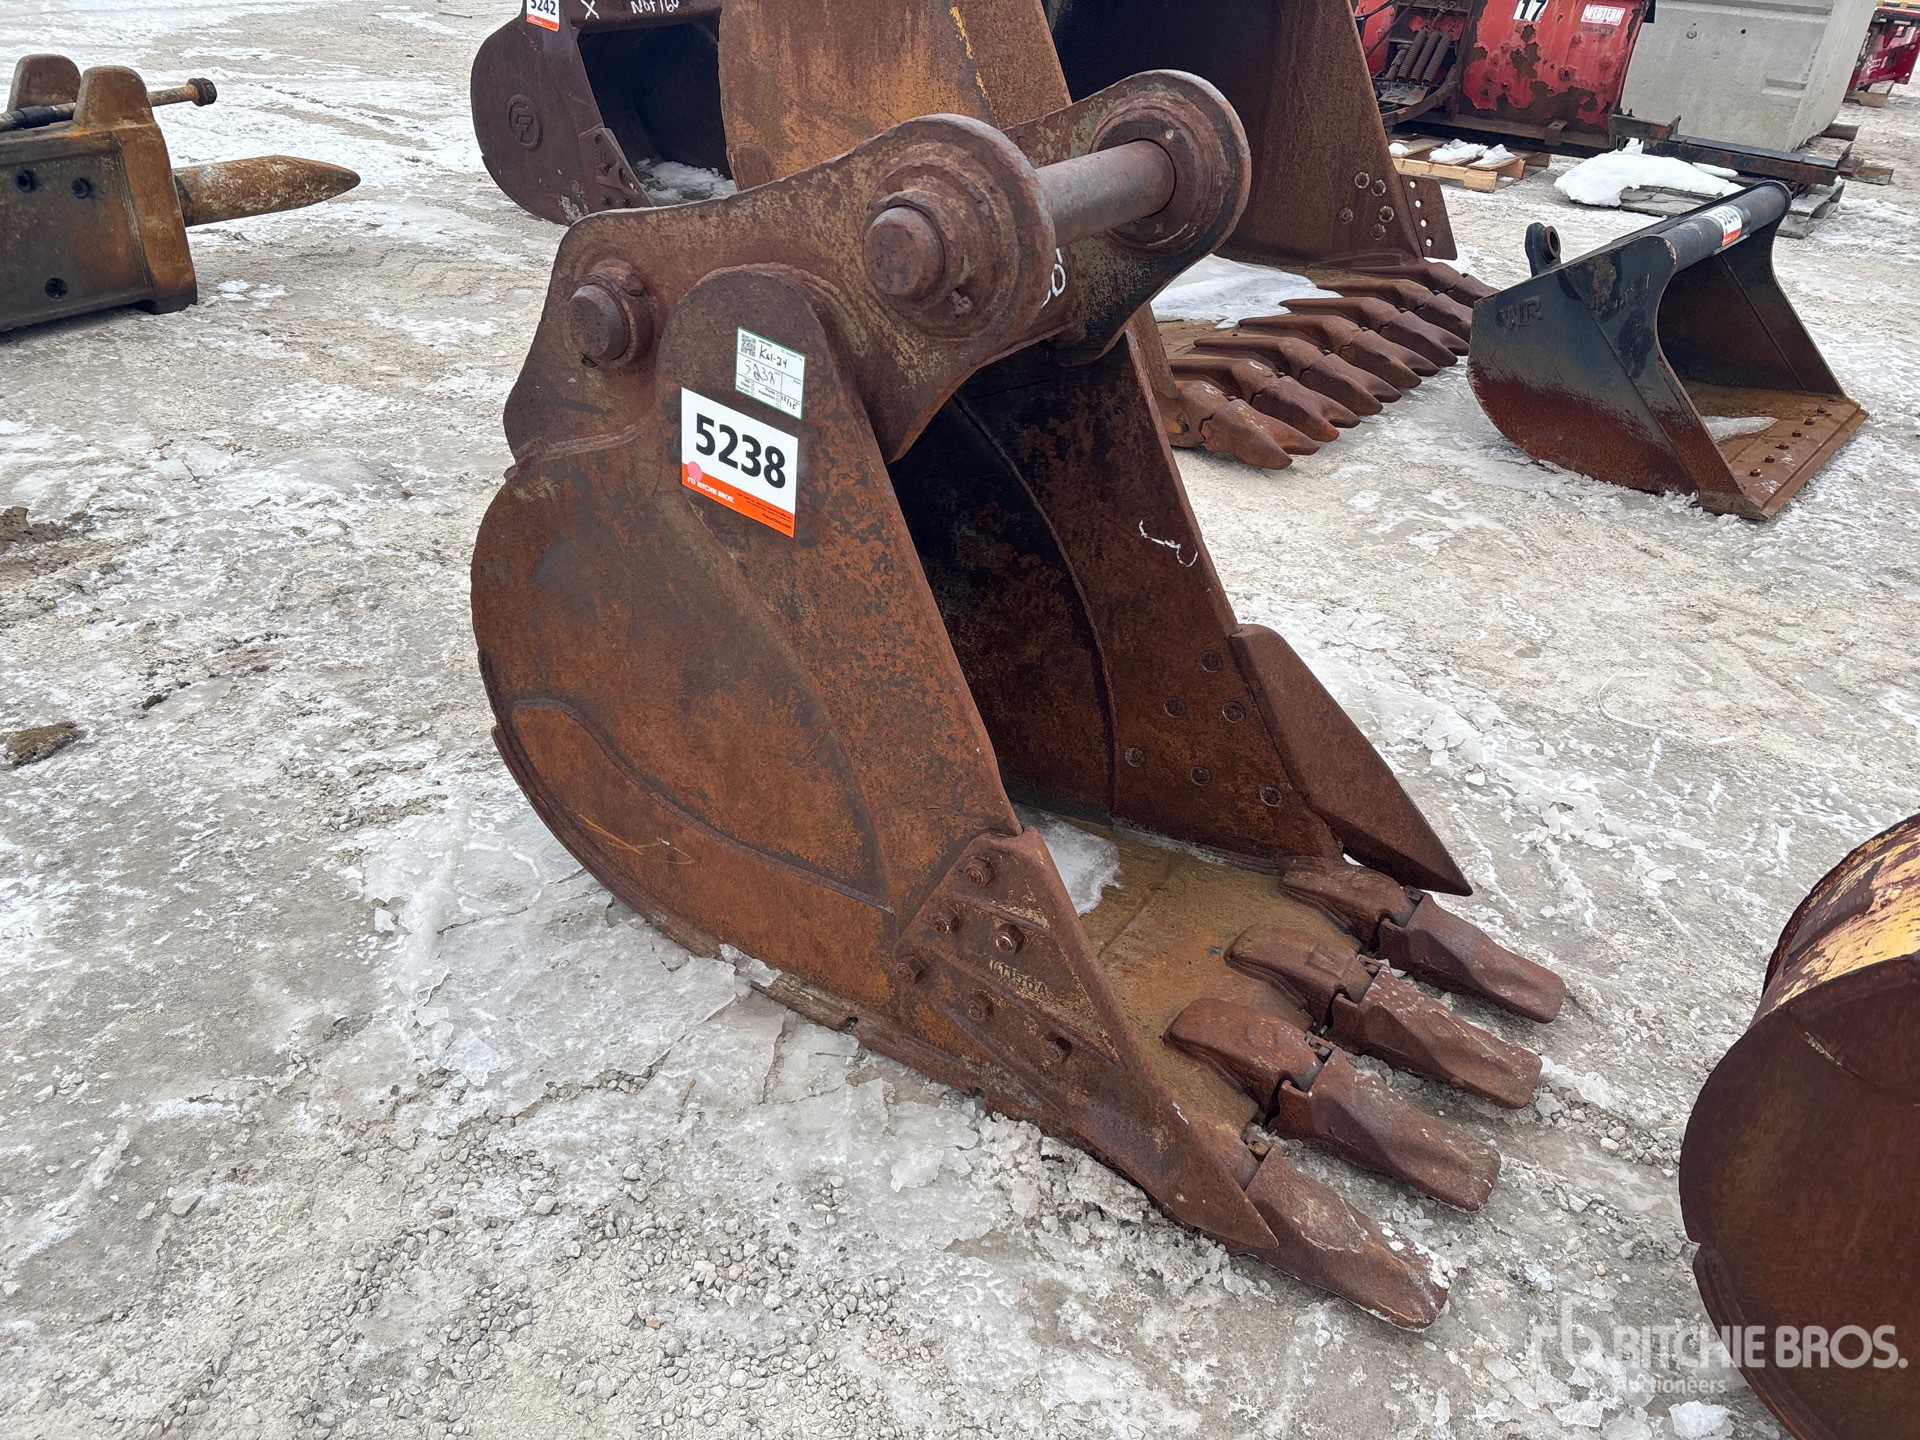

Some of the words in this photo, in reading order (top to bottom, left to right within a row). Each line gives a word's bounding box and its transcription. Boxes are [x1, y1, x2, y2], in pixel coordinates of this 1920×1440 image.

[530, 0, 556, 16] 5242
[1584, 5, 1622, 20] WESTERN
[695, 412, 786, 489] 5238
[697, 480, 718, 497] RITCHIE
